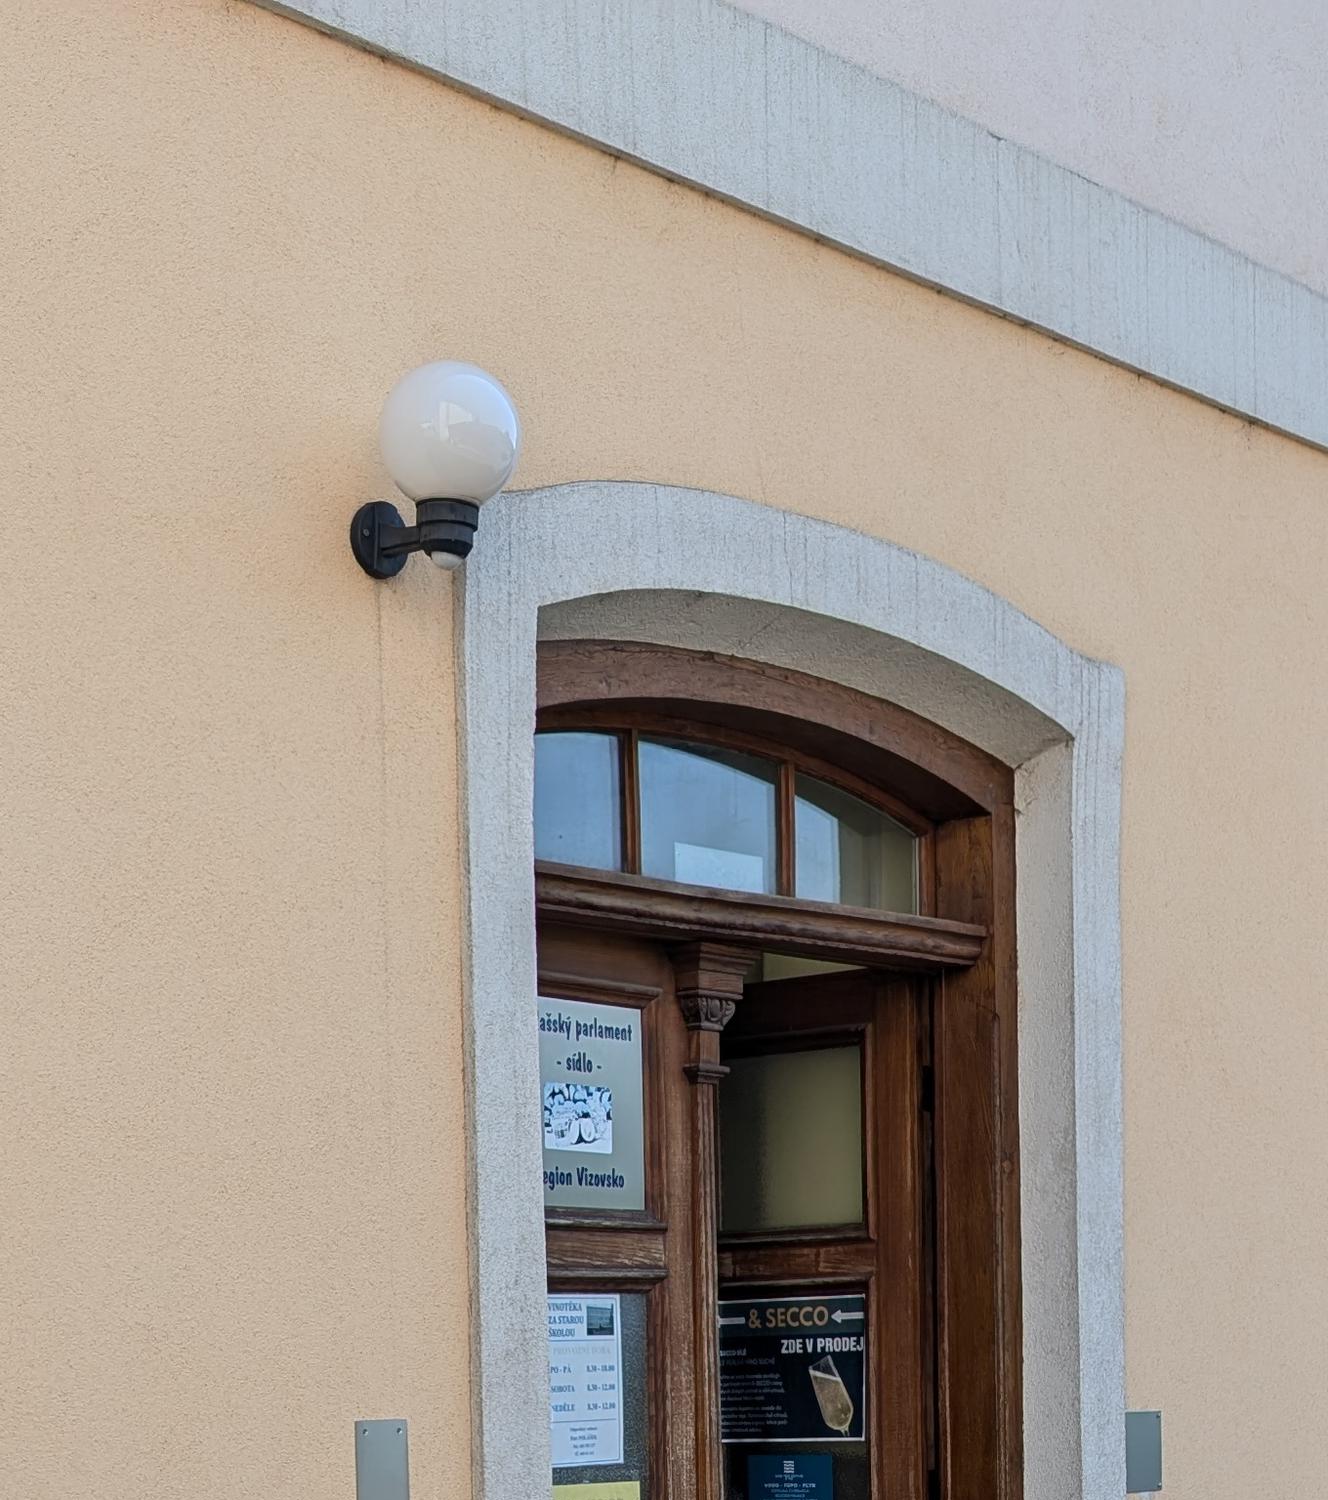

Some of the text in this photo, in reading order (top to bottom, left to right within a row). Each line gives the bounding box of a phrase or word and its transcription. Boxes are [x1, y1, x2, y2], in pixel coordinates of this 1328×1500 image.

[537, 1012, 632, 1041] ašský parlament
[566, 1051, 593, 1073] sídlo
[576, 1166, 625, 1188] Vizovsko
[548, 1315, 584, 1325] ZA STAROU
[748, 1305, 829, 1329] & SECCO
[548, 1327, 576, 1338] ŠKOLOU
[780, 1336, 864, 1354] ZDE V PRODEJ
